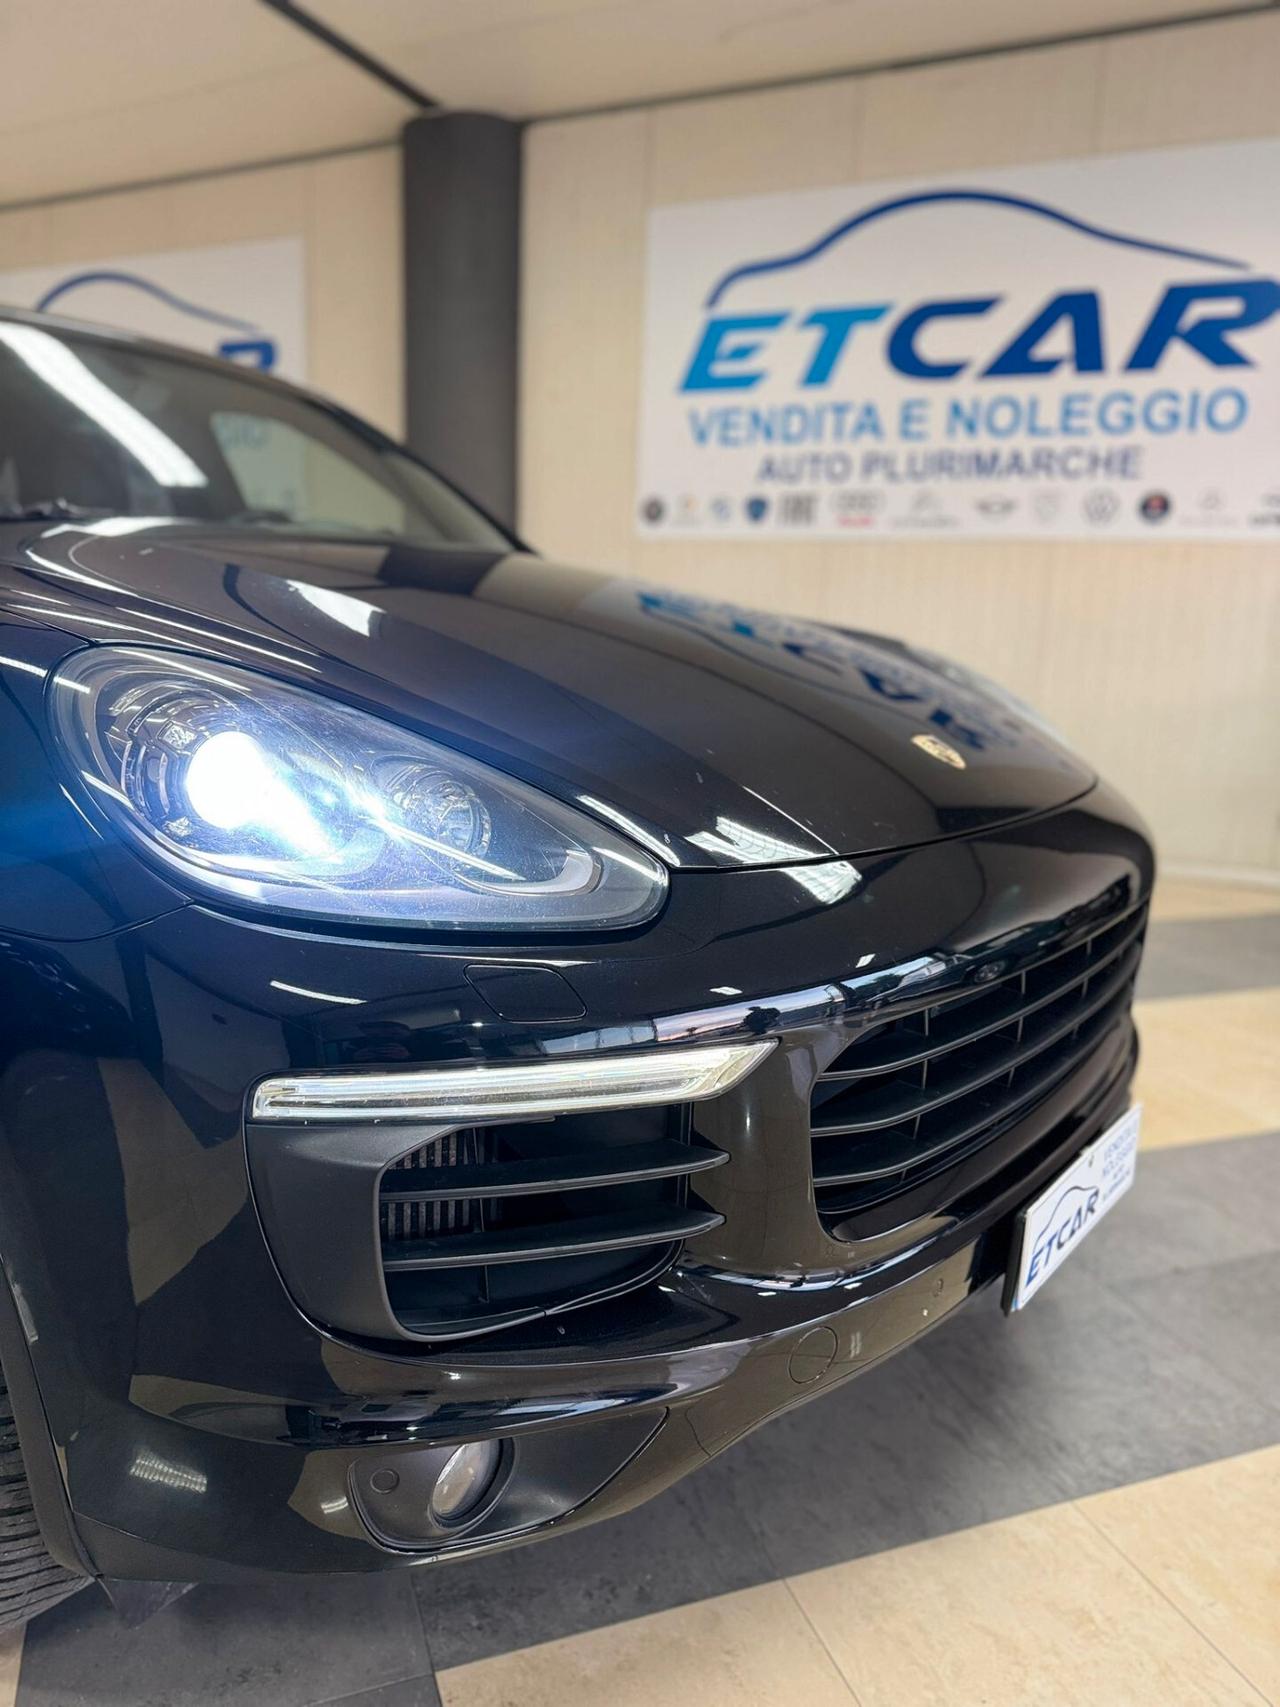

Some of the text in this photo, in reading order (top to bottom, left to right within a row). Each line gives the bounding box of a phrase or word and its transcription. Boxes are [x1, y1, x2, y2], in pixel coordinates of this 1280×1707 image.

[678, 279, 1280, 393] ETCAR
[688, 388, 1248, 446] VENDITA E NOLEGGIO
[757, 446, 1142, 483] AUTO PLURIMARCHE
[1026, 1189, 1099, 1286] ETCAR
